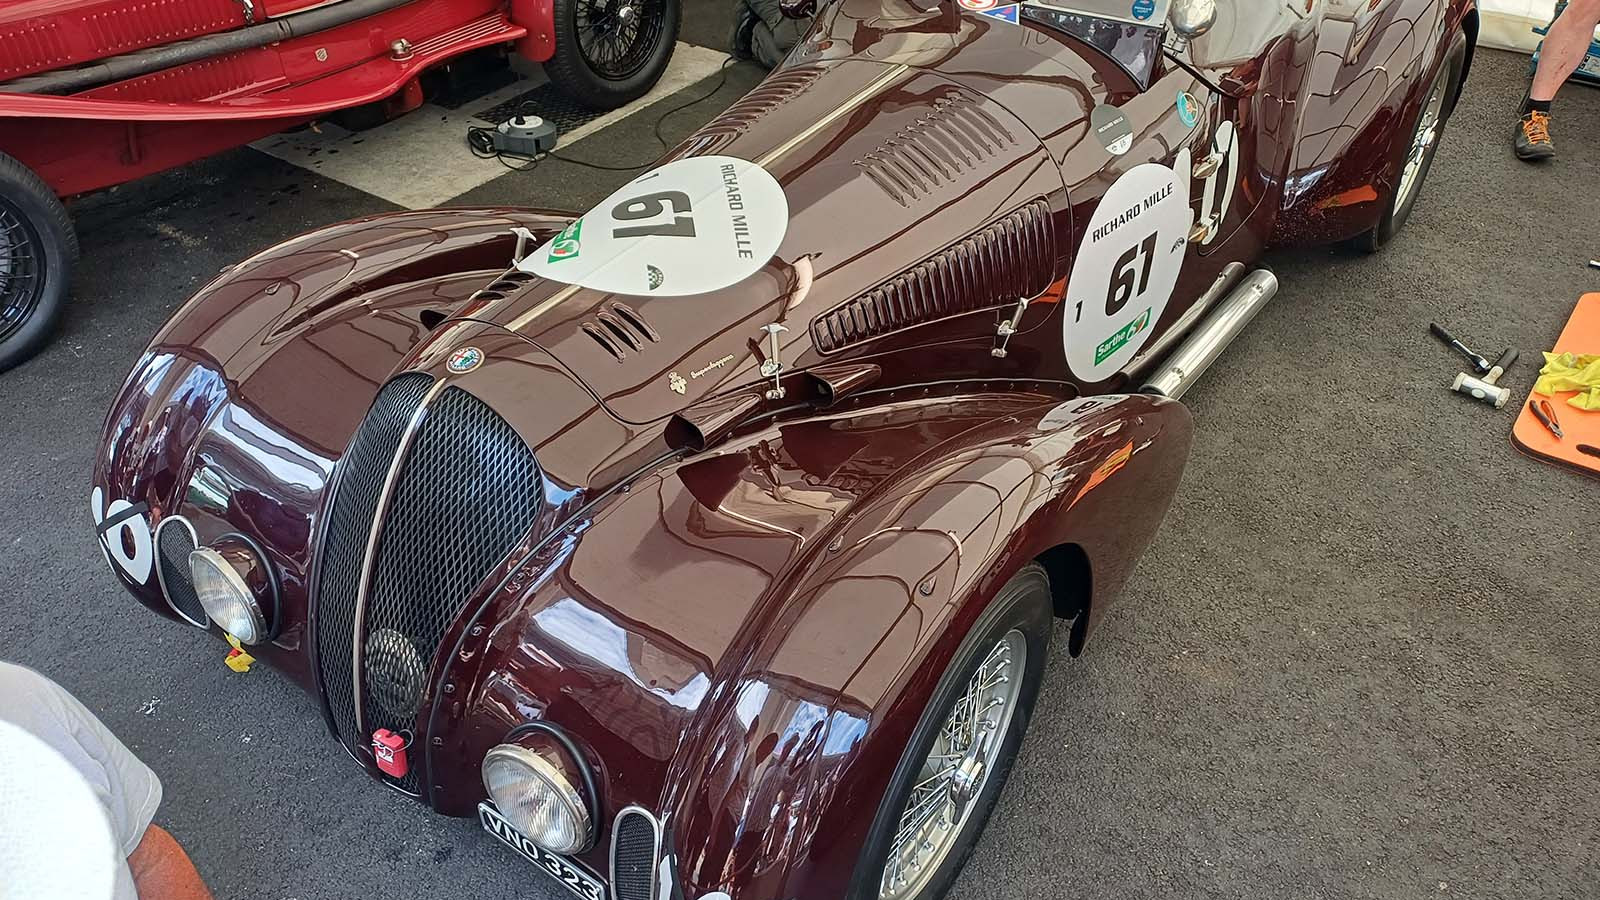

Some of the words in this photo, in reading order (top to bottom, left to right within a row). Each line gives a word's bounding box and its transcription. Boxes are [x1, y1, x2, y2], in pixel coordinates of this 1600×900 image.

[611, 191, 696, 239] 61
[720, 164, 743, 211] RICHARD
[732, 215, 753, 259] MILLE
[1093, 206, 1141, 243] RICHARD
[1143, 183, 1174, 214] MILLE
[1105, 230, 1159, 317] 61
[1075, 300, 1083, 323] 1
[1097, 329, 1126, 356] Sarthe
[486, 812, 539, 860] VNO
[544, 854, 600, 900] 323
